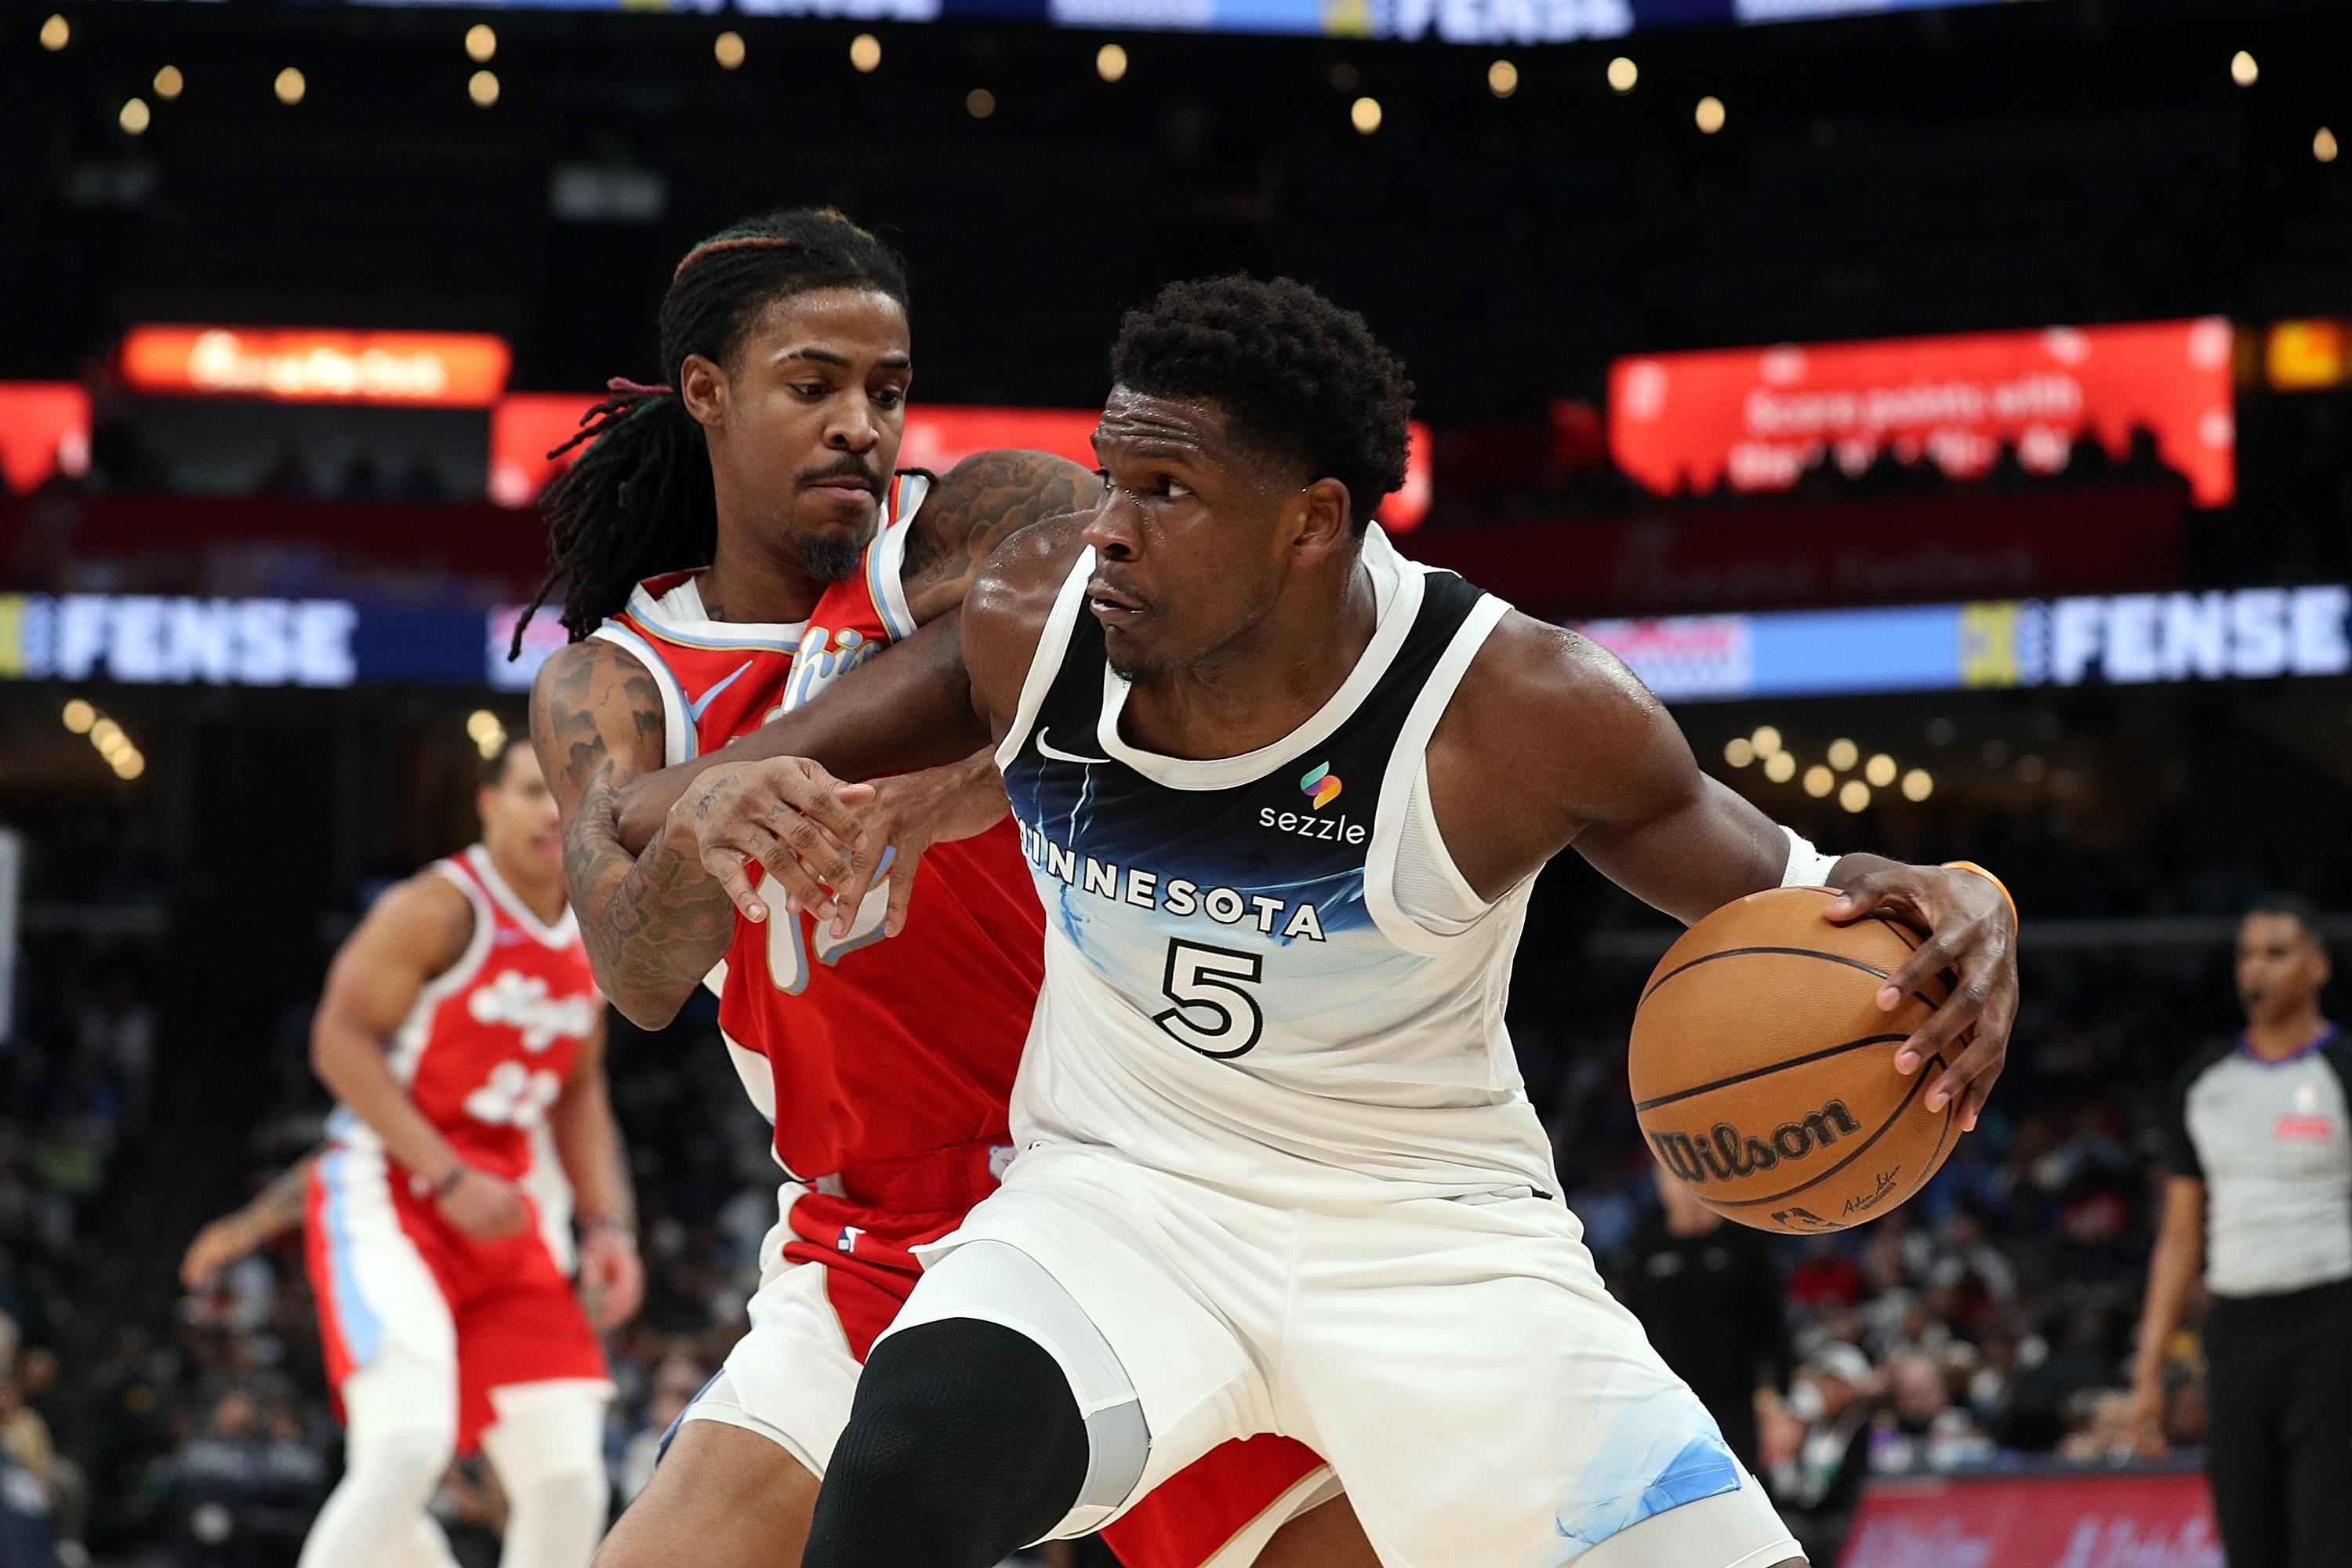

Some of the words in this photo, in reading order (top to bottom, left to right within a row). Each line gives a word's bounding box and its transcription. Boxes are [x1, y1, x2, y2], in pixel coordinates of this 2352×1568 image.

[59, 593, 358, 687] FENSE
[2052, 584, 2350, 688] FENSE
[1259, 807, 1366, 844] sezzle
[1152, 936, 1264, 1059] 5
[1647, 1099, 1862, 1184] Wilson
